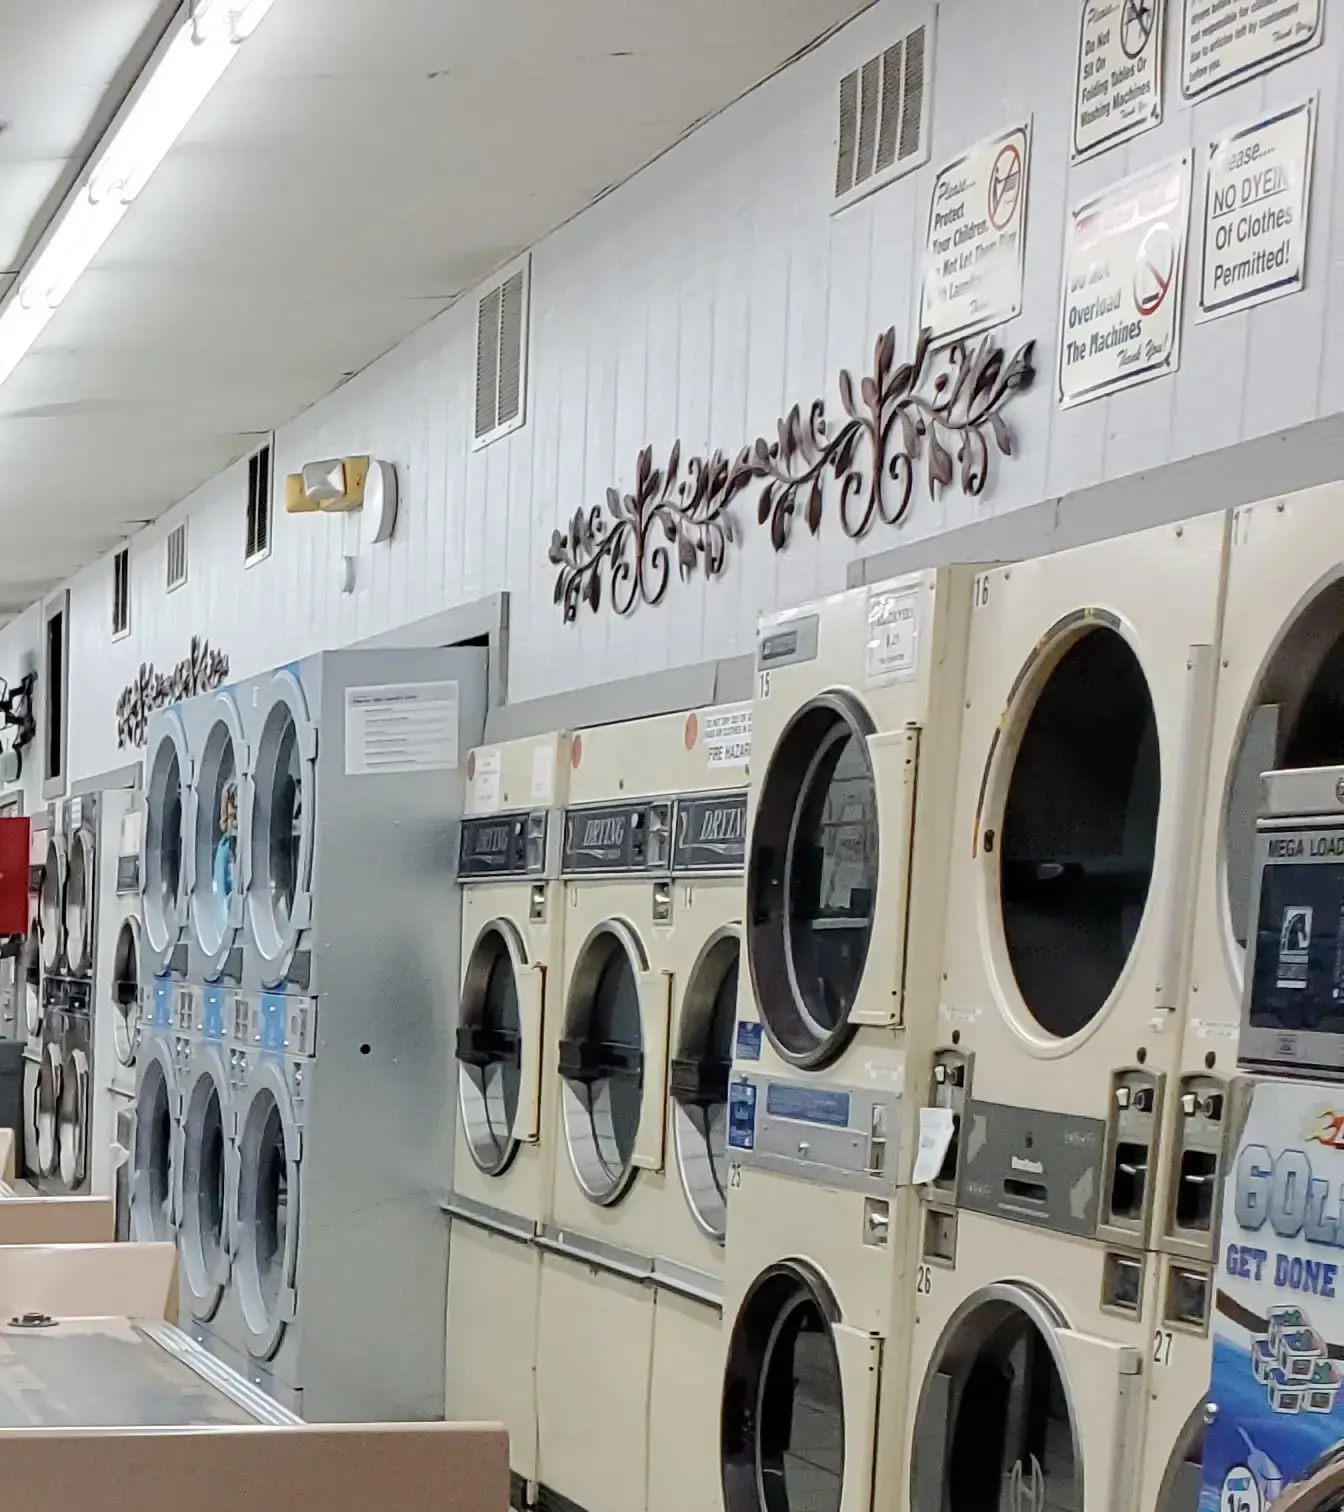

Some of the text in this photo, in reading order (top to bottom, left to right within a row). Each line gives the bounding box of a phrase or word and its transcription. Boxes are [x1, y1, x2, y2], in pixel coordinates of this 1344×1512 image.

[1084, 39, 1096, 56] Do
[1095, 55, 1106, 74] On
[1081, 79, 1109, 104] Folding
[1111, 63, 1135, 88] Tables
[1112, 80, 1151, 111] Machines
[1213, 183, 1237, 216] NO
[933, 201, 965, 232] Protect
[1215, 205, 1294, 251] Of Clothes
[932, 236, 953, 255] Your
[1213, 238, 1291, 290] Permitted!
[1068, 291, 1122, 330] Overload
[1066, 319, 1143, 366] The Machines
[975, 575, 989, 607] 16
[759, 671, 771, 699] 15
[708, 742, 751, 761] FIRE HAZAR
[699, 807, 746, 841] DRYIN
[1268, 839, 1304, 858] MEGA
[916, 1265, 932, 1296] 26
[1225, 1242, 1339, 1299] GET DONE
[1152, 1329, 1173, 1367] 27
